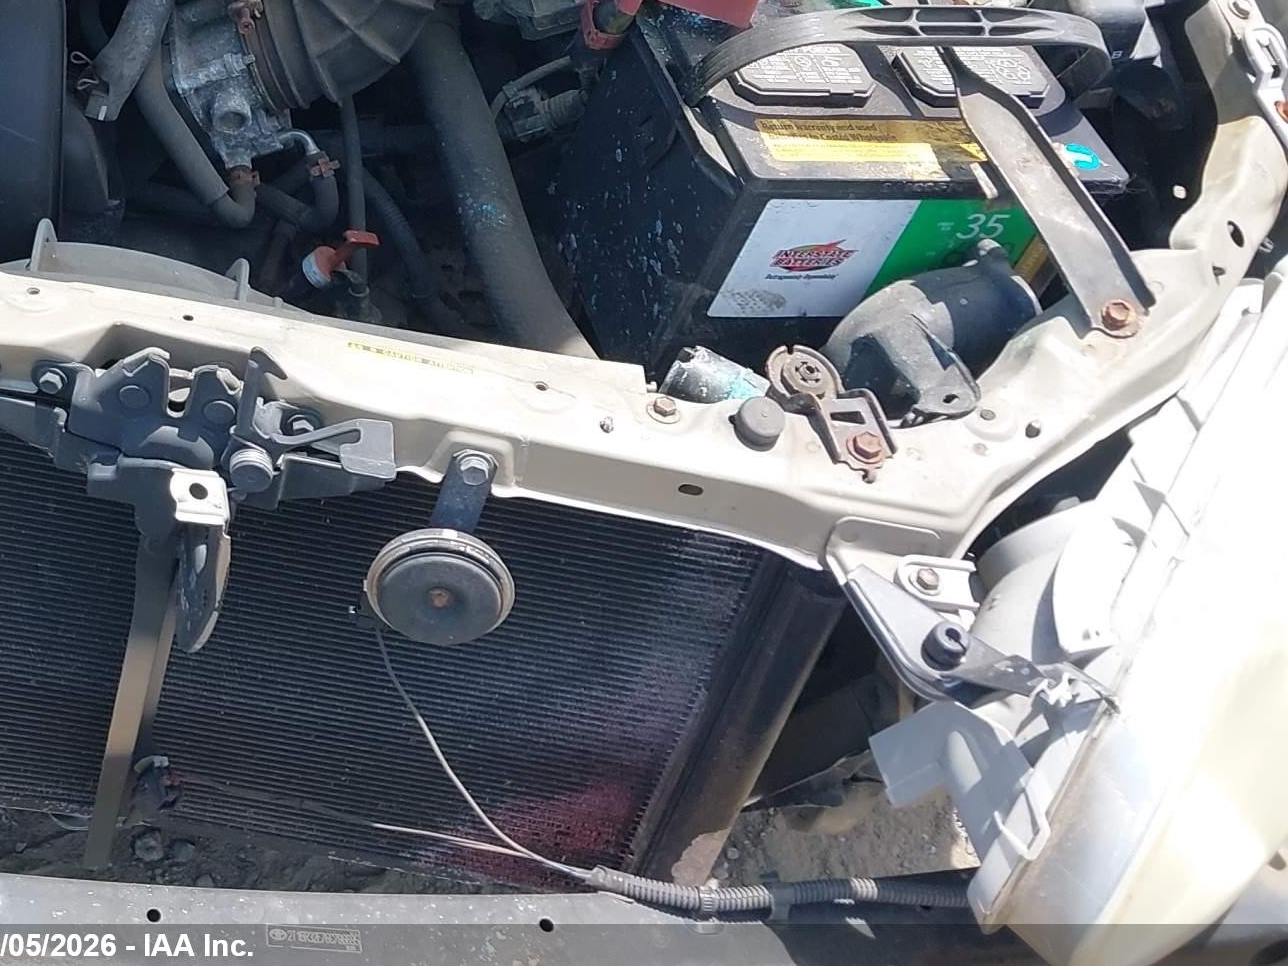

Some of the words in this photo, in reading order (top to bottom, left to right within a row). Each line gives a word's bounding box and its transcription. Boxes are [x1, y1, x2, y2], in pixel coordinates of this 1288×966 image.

[956, 214, 1010, 239] 35
[772, 249, 856, 259] INTERSTATE
[770, 258, 845, 267] BATTERIES
